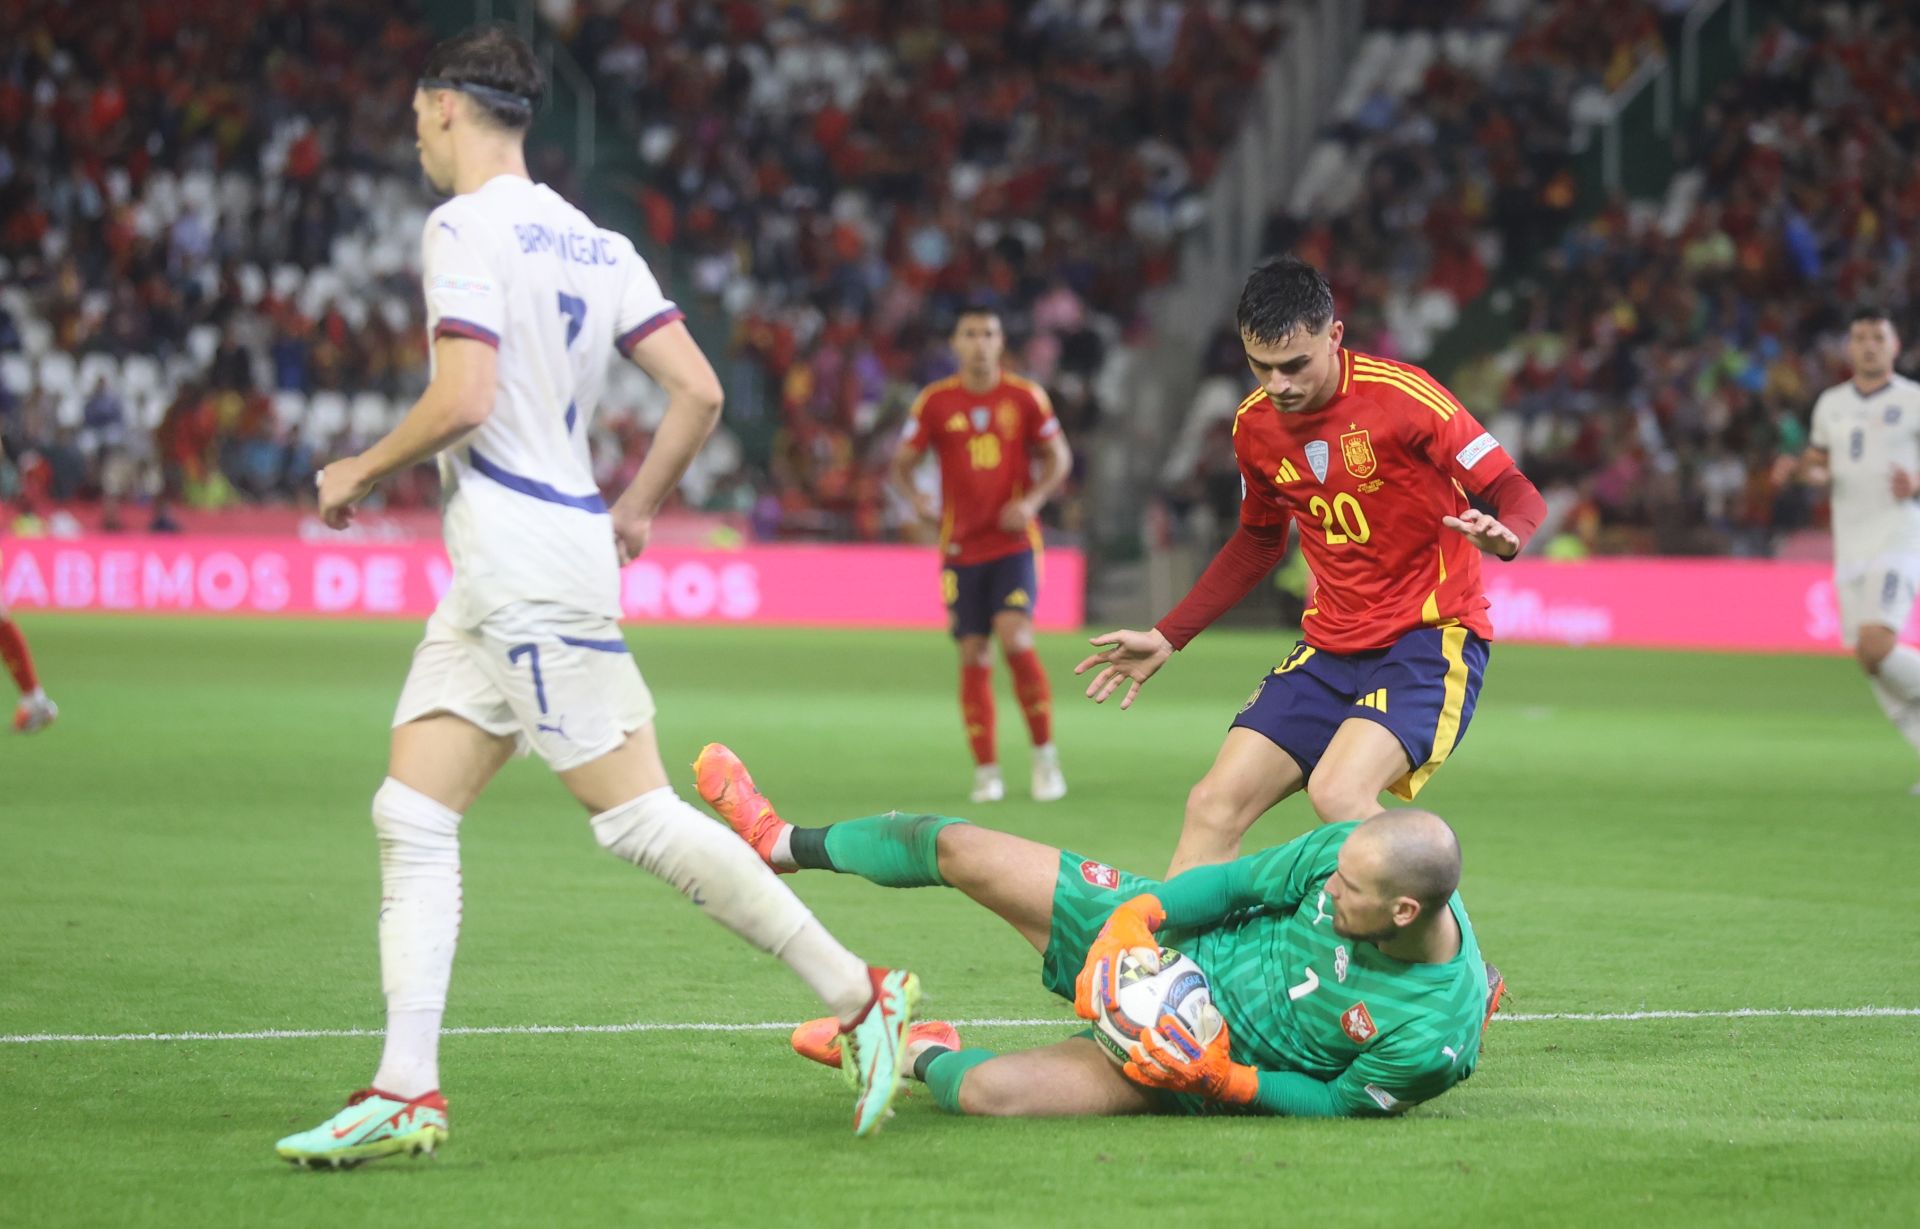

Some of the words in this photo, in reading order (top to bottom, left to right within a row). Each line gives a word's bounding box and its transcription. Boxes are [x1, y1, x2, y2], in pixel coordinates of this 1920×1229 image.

[1309, 492, 1371, 545] 20
[312, 555, 405, 611] DE
[508, 642, 548, 714] 7
